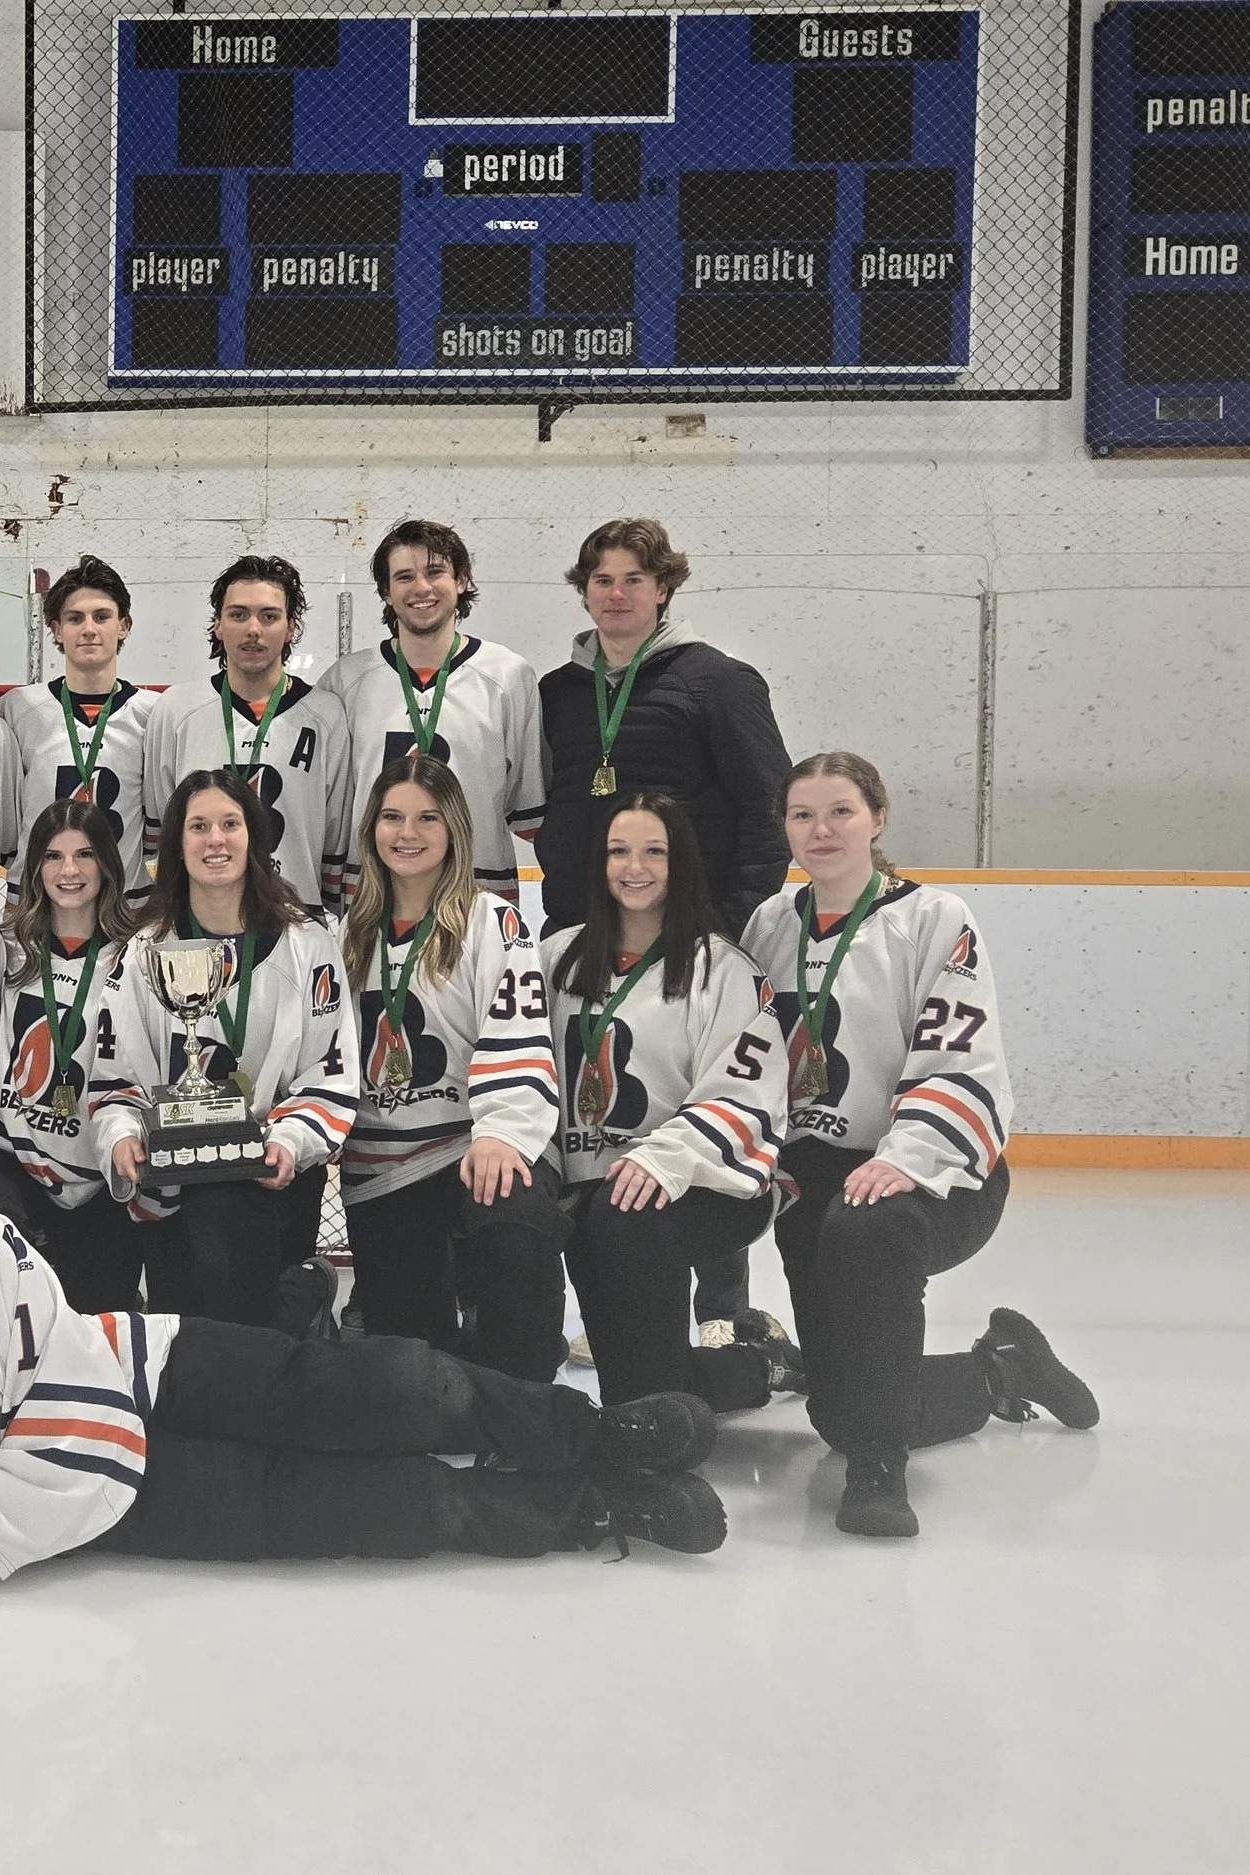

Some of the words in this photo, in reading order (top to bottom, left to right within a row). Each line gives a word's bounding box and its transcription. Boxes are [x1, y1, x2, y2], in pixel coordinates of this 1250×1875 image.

[192, 26, 278, 65] Home
[798, 19, 913, 58] Guests
[1146, 89, 1250, 133] penalt
[463, 146, 565, 190] period
[131, 251, 221, 292] player
[262, 251, 380, 292] penalty
[694, 247, 816, 289] penalty
[860, 246, 954, 288] player
[1144, 237, 1239, 276] Home
[442, 321, 521, 358] shots
[531, 328, 565, 357] on
[575, 321, 633, 362] goal
[289, 726, 316, 773] A
[487, 967, 549, 1021] 33
[96, 1007, 117, 1061] 4
[910, 996, 988, 1054] 27
[315, 1028, 345, 1077] 4
[725, 1031, 772, 1082] 5
[798, 1110, 849, 1138] ZERS
[14, 1303, 40, 1373] 1
